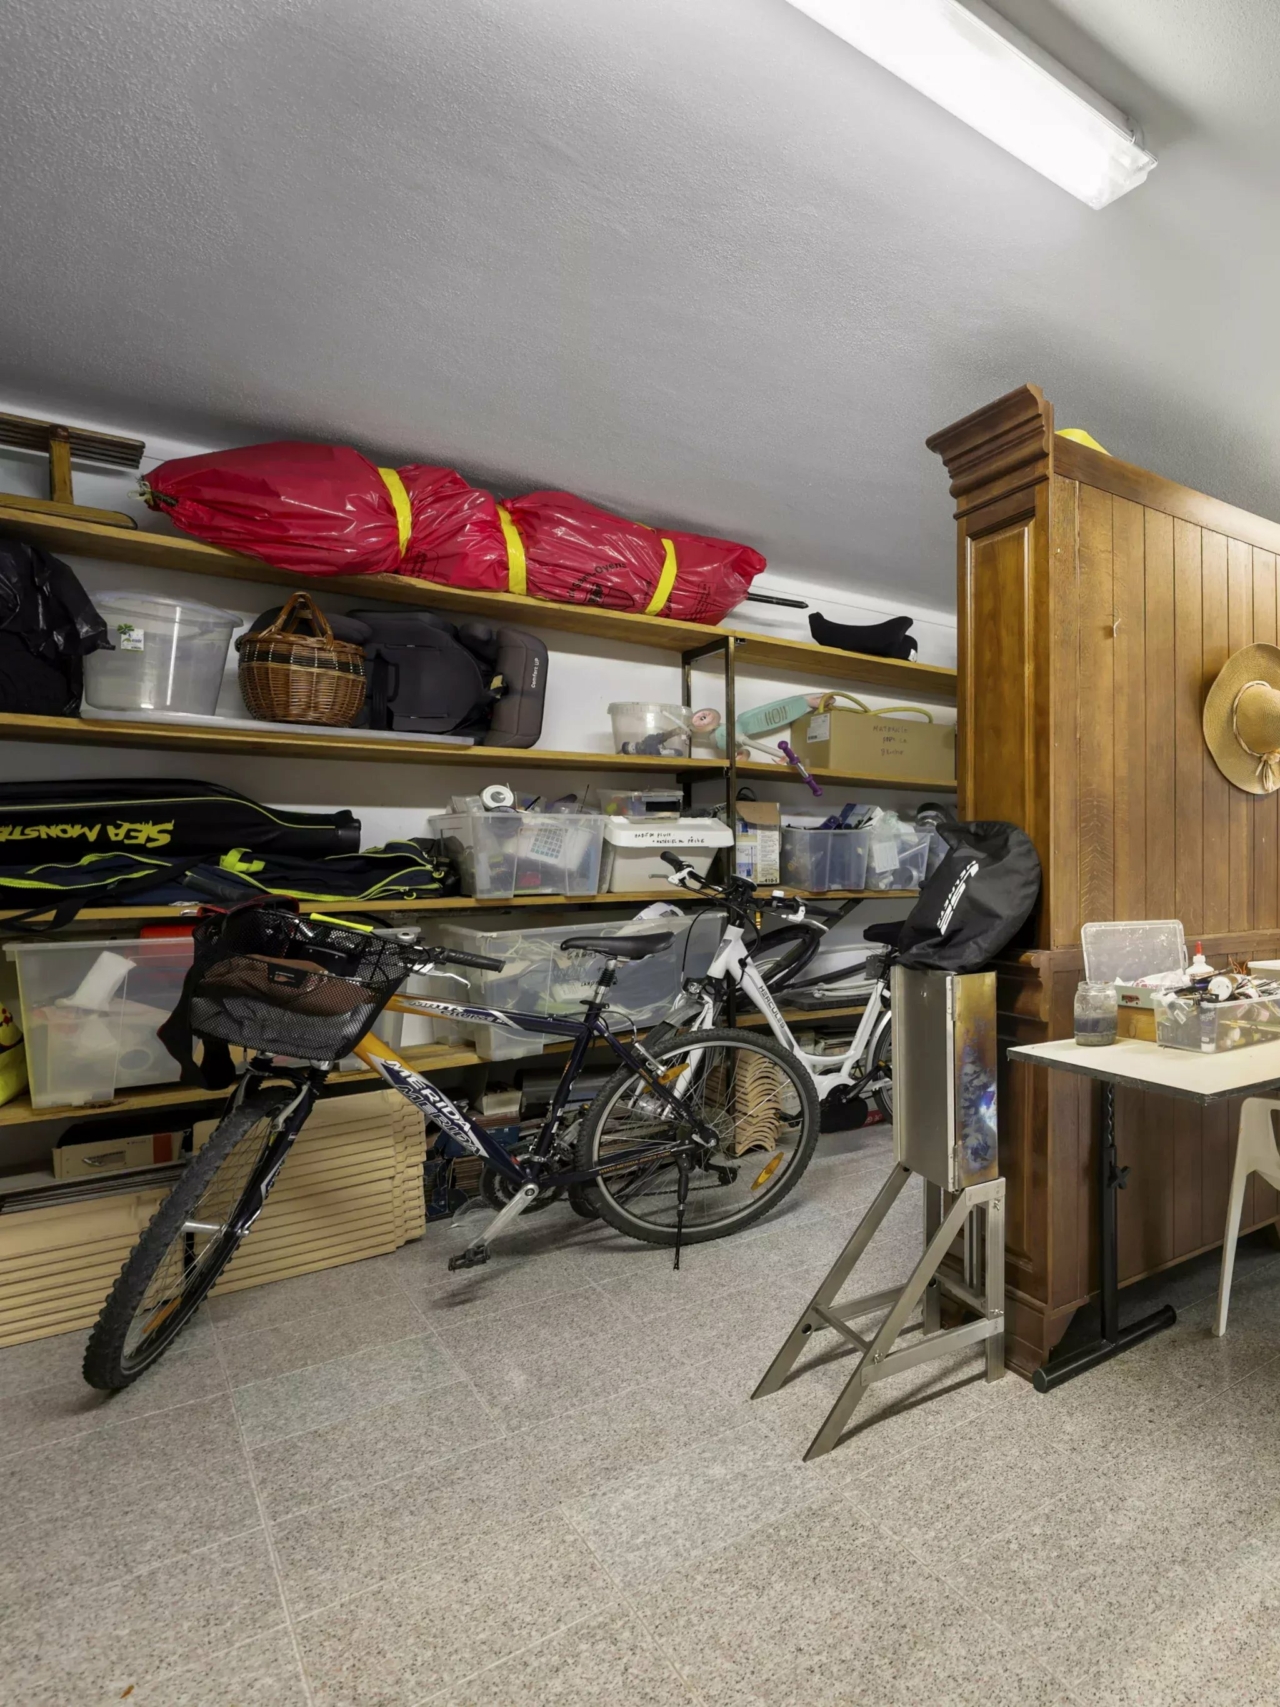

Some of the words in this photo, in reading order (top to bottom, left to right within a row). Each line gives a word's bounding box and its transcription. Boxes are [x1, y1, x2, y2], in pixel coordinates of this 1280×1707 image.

[106, 819, 175, 848] SEA
[758, 985, 786, 1029] HERCULES
[383, 1059, 472, 1133] MERIDA
[395, 1084, 481, 1157] MERIDA
